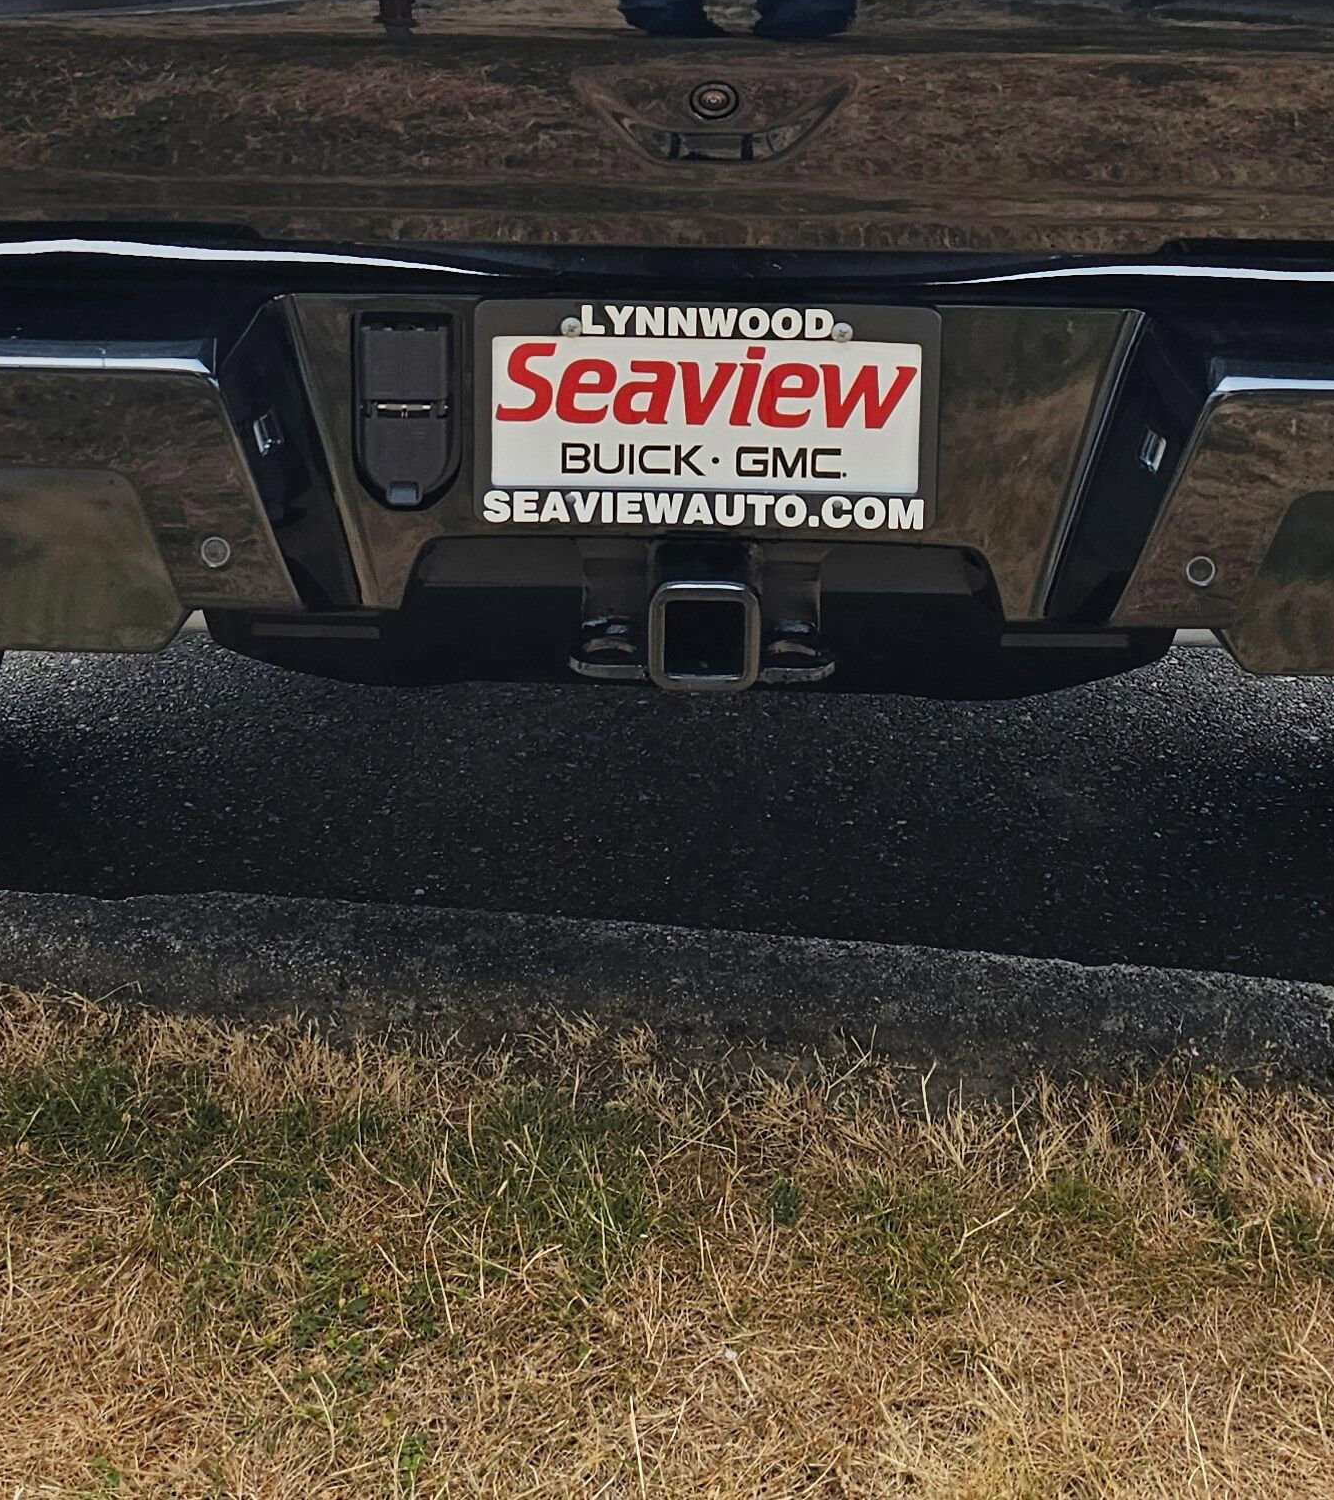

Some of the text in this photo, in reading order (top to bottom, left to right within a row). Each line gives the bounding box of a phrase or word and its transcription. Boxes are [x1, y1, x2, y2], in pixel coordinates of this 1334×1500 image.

[581, 304, 835, 340] LYNNWOOD
[495, 342, 917, 430] Seaview
[561, 442, 704, 476] BUICK
[482, 491, 925, 530] SEAVIEWAUTO.COM
